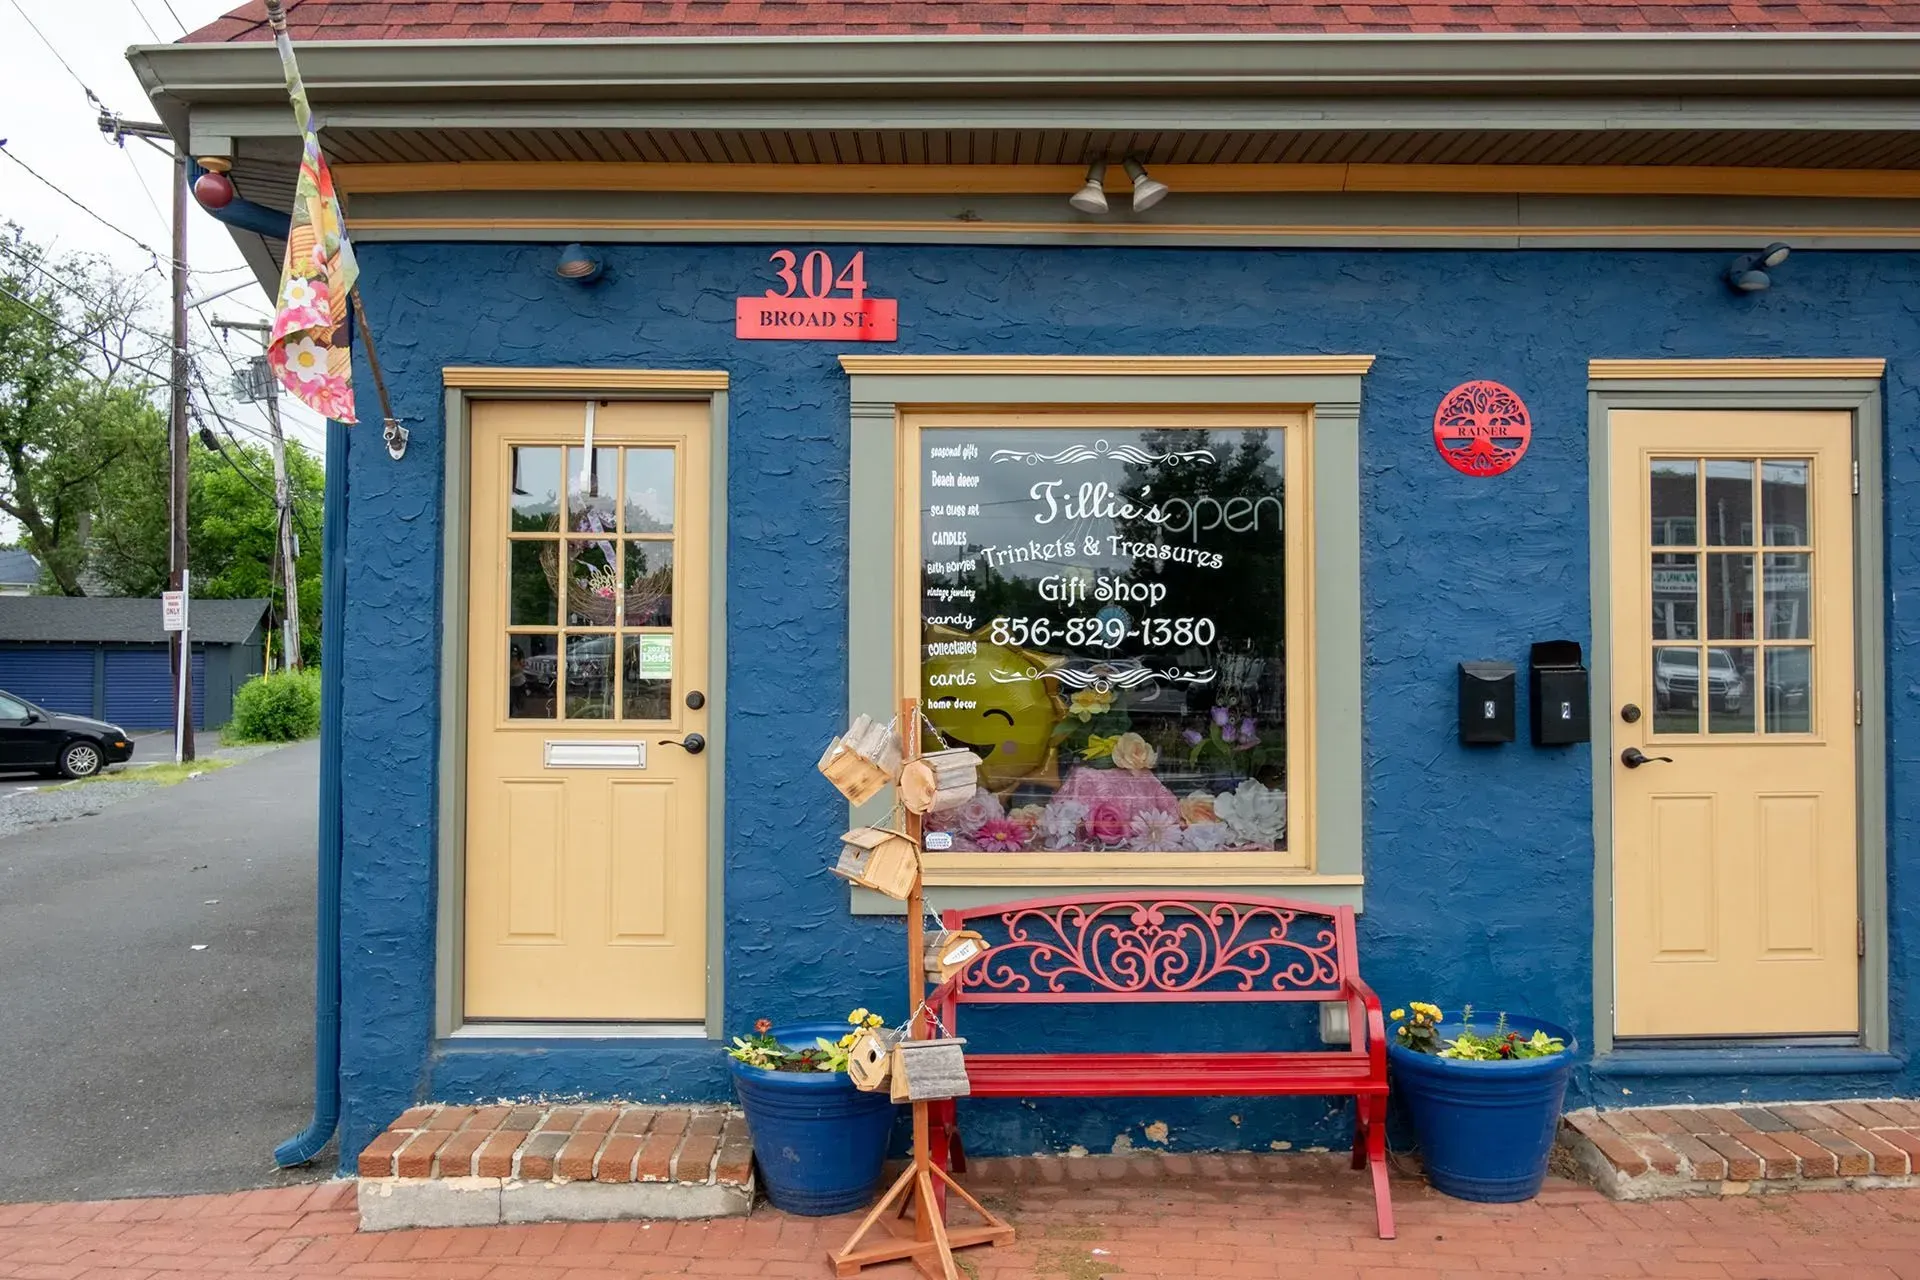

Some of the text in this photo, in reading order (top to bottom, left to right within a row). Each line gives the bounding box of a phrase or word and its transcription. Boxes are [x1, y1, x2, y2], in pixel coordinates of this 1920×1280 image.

[765, 249, 868, 300] 304
[760, 310, 874, 327] BROAD ST.
[1458, 427, 1507, 436] RAINER
[930, 444, 979, 460] seasonal gifts
[931, 470, 980, 487] Beach decor
[1030, 479, 1172, 524] Tillie's
[1161, 496, 1283, 543] open
[932, 532, 967, 546] CANDLES
[981, 535, 1223, 569] Trinkets & Treasures
[927, 587, 949, 602] vintage
[1038, 574, 1167, 607] Gift Shop
[927, 613, 976, 629] candy
[990, 616, 1216, 649] 856-829-1380
[643, 652, 671, 663] best
[929, 669, 977, 687] cards
[927, 698, 977, 709] home decor
[1485, 701, 1494, 718] 3
[1561, 702, 1571, 719] 2
